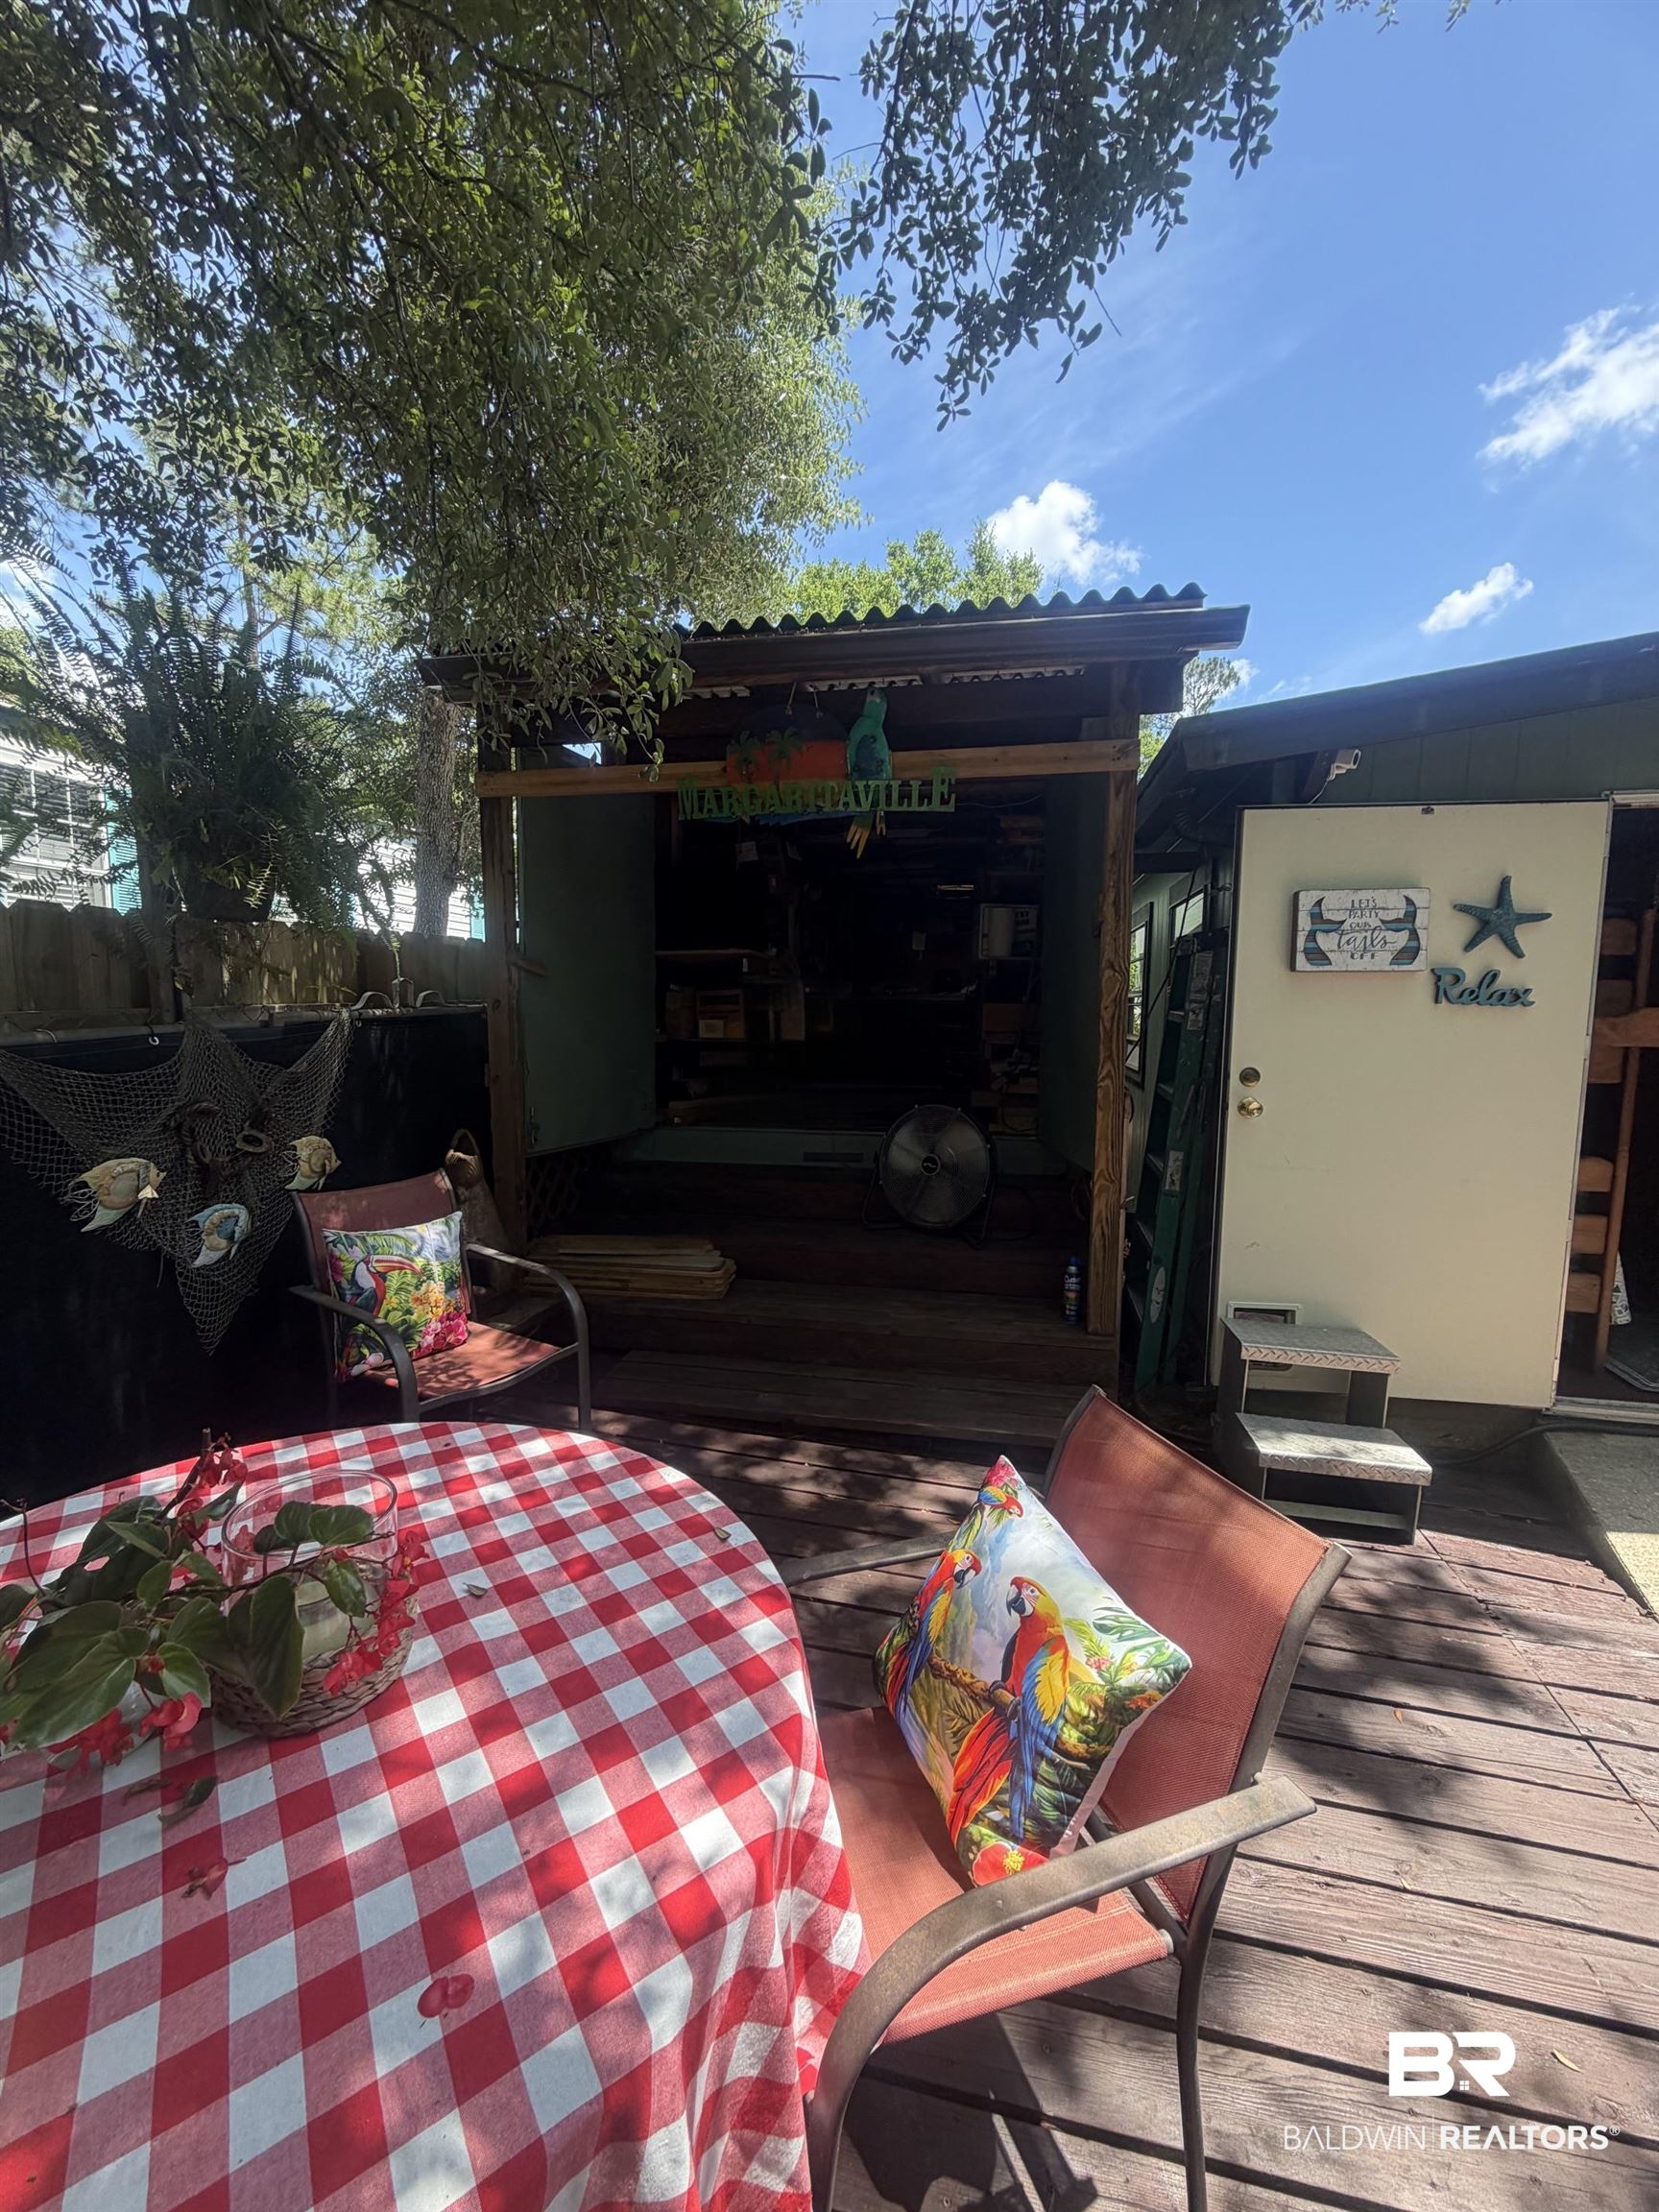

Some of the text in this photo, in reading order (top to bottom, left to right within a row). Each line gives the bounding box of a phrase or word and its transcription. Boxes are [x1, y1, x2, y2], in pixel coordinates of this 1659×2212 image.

[677, 766, 956, 820] MARGARITAVILLE
[1348, 910, 1380, 919] PARTY
[1351, 897, 1378, 908] LET'S
[1431, 967, 1535, 1007] Relax
